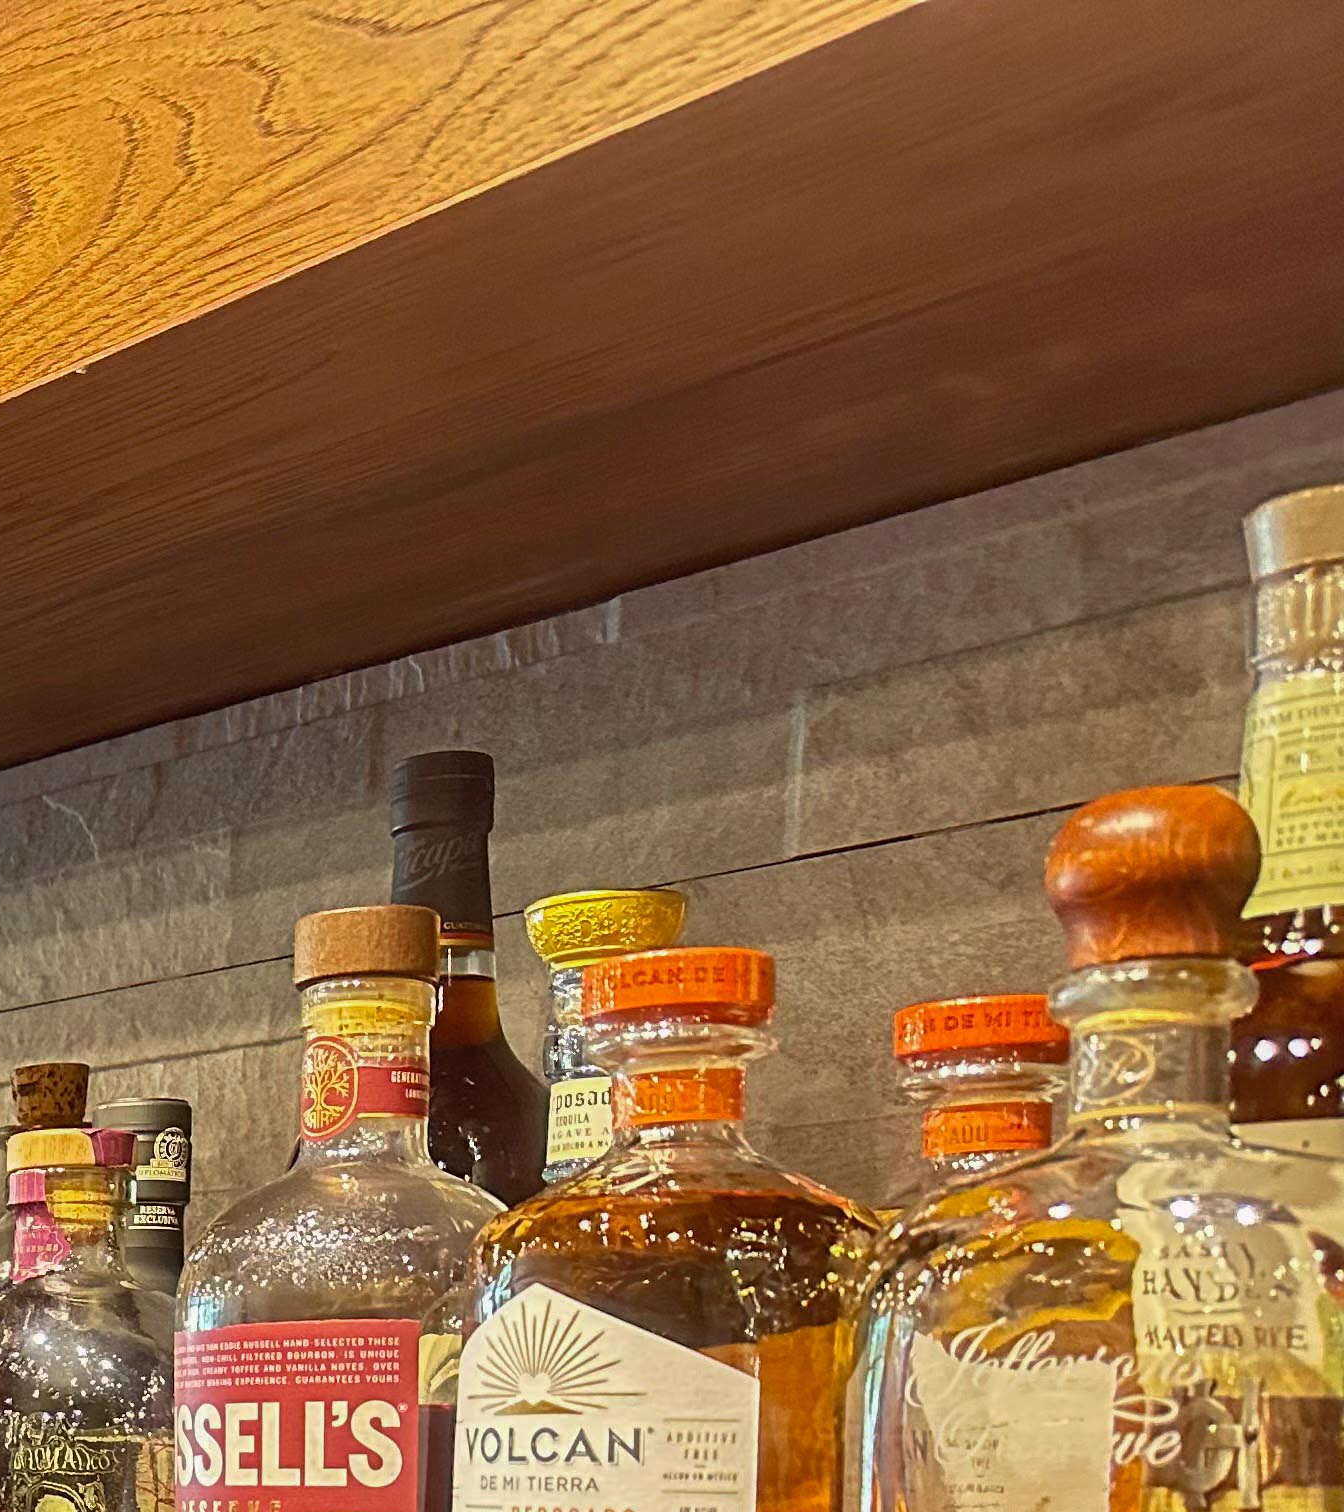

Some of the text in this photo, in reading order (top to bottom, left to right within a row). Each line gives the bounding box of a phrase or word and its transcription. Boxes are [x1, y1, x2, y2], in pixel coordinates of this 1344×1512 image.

[555, 1113, 590, 1127] TEQUILA
[140, 1205, 176, 1216] RESERVA
[243, 1340, 281, 1350] RUSSELL
[368, 1337, 401, 1347] THESE
[241, 1351, 283, 1362] FILTERED
[344, 1351, 356, 1359] IS
[359, 1349, 401, 1360] UNIQUE
[230, 1365, 261, 1375] TOFFEE
[263, 1364, 282, 1373] AND
[286, 1363, 326, 1373] VANILLA
[372, 1361, 401, 1372] OVER
[294, 1374, 362, 1385] GUARANTEES
[365, 1374, 401, 1384] YOURS
[176, 1399, 404, 1488] SSELL'S
[665, 1431, 738, 1445] ADDITIVE
[466, 1426, 646, 1466] VOLCAN
[683, 1448, 718, 1461] FREE
[480, 1474, 600, 1493] DE MI TIERRA
